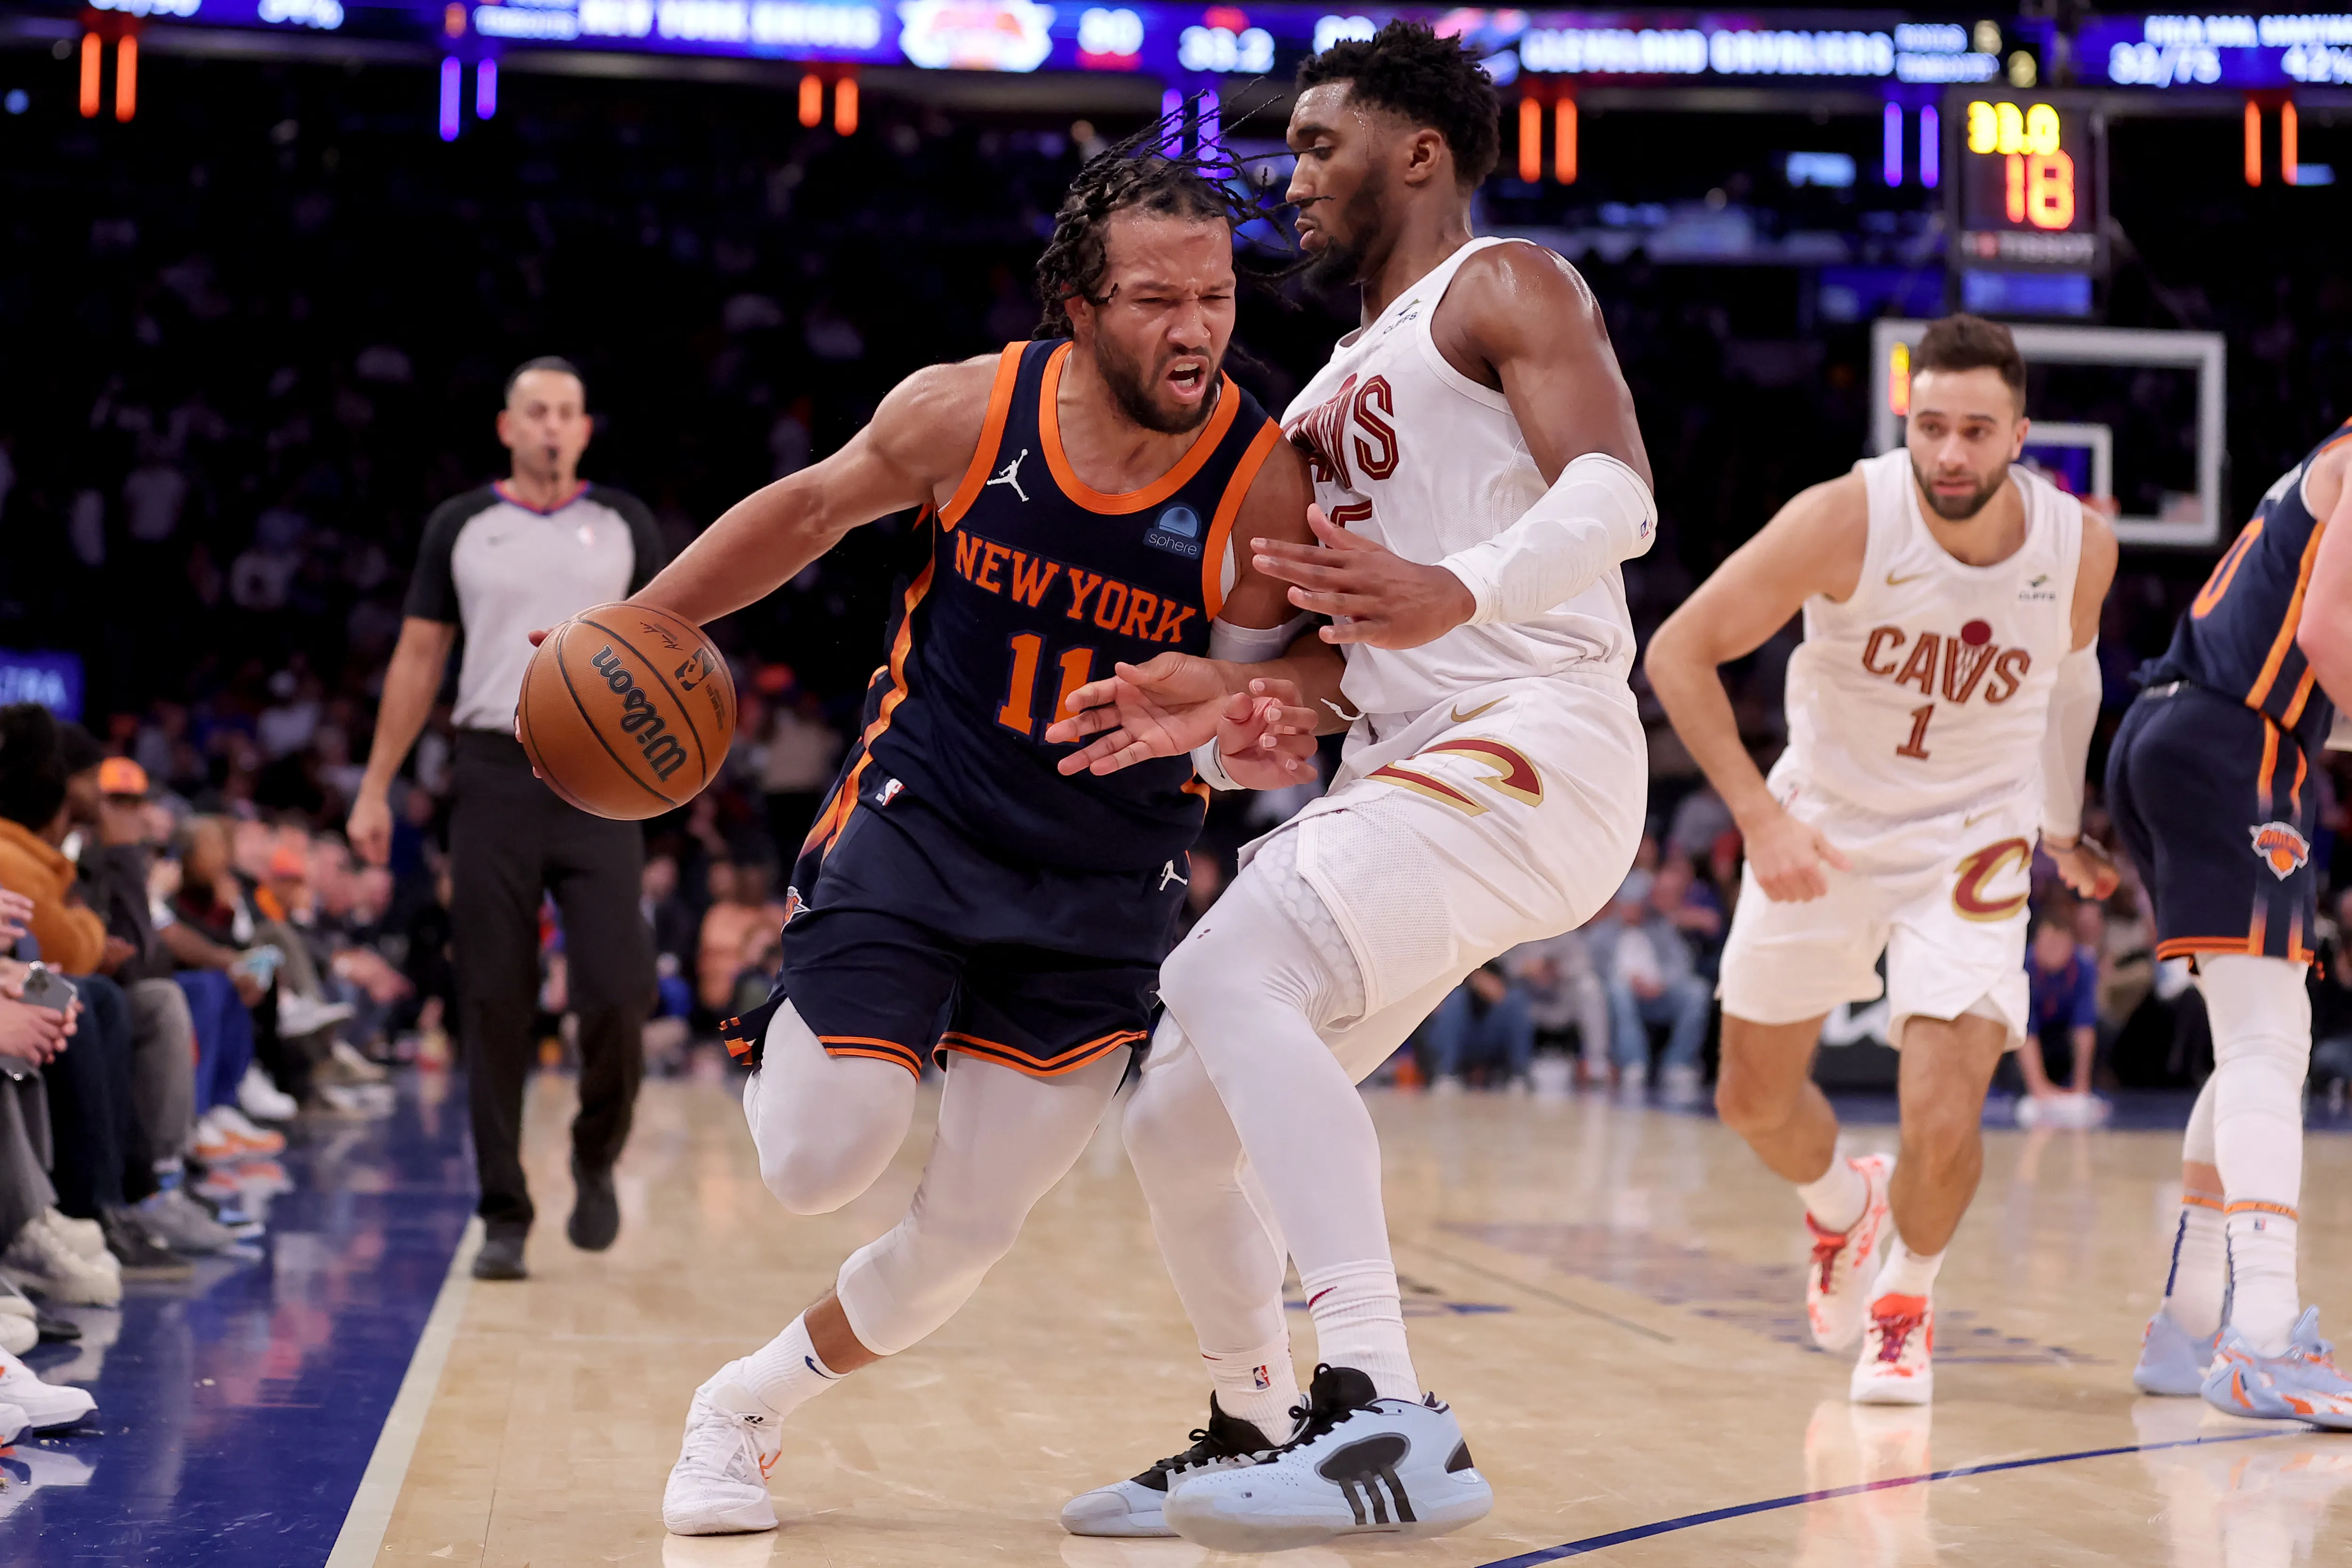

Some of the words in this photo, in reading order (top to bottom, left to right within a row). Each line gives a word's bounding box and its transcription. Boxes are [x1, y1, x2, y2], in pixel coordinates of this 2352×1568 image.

[2006, 149, 2075, 229] 18
[1383, 311, 1418, 335] CLIFFS
[1148, 532, 1197, 556] sphere
[955, 530, 1059, 608] NEW
[1067, 569, 1196, 643] YORK
[998, 633, 1093, 743] 11
[1863, 627, 2032, 704] CAVS
[591, 645, 687, 782] Wilson
[1897, 704, 1935, 761] 1
